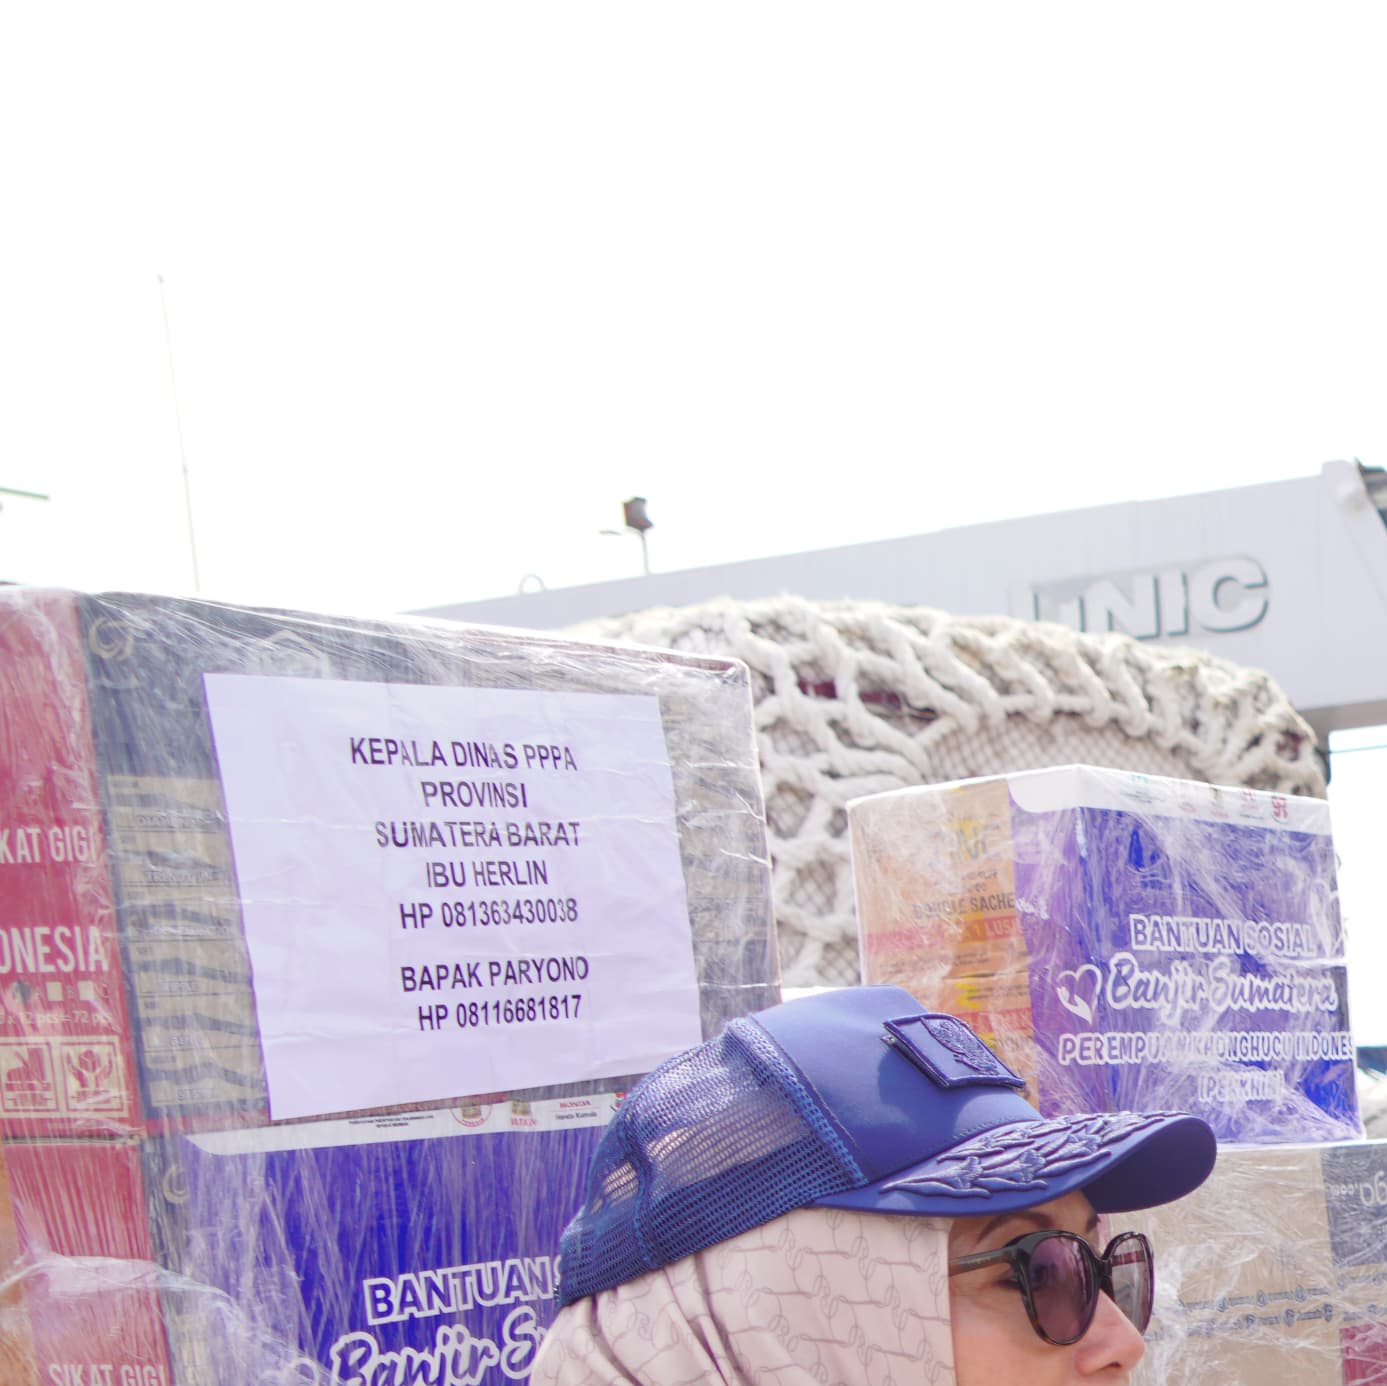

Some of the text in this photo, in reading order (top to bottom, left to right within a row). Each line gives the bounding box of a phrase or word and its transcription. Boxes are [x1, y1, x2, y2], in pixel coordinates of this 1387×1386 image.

[350, 737, 578, 771] KEPALA DINAS PPPA
[421, 781, 528, 808] PROVINSI
[375, 820, 580, 848] SUMATERA BARAT
[426, 859, 549, 888] IBU HERLIN
[399, 897, 578, 929] HP 081363430038
[0, 926, 109, 974] NESIA
[1128, 914, 1318, 955] BANTUAN SOSIAL
[401, 955, 590, 992] BAPAK PARYONO
[1106, 952, 1339, 1025] Banjir Sumatera
[418, 994, 582, 1031] HP 08116681817
[363, 1256, 551, 1325] BANTUAN
